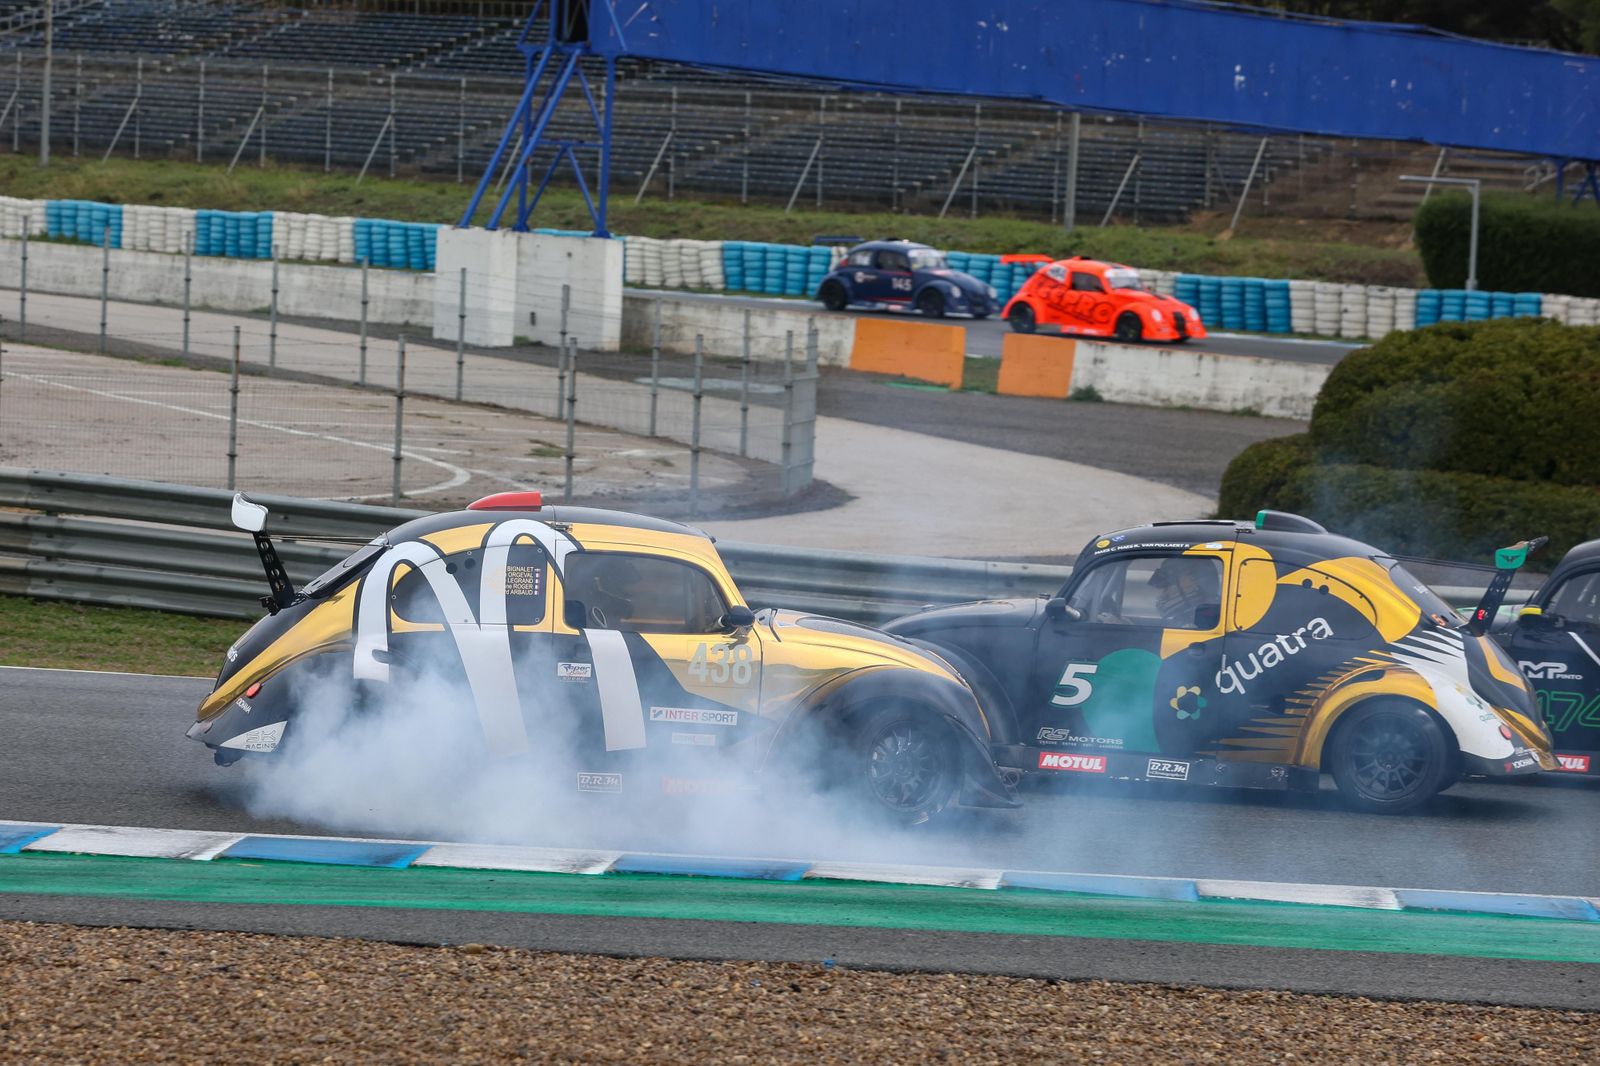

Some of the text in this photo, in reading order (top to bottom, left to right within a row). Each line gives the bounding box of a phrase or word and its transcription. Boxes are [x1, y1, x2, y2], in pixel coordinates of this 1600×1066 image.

[687, 643, 753, 684] 438
[1215, 617, 1334, 695] quatra
[1051, 664, 1098, 706] 5
[245, 742, 277, 750] RACING
[1068, 736, 1124, 745] MOTORS
[1041, 755, 1103, 770] MOTUL
[1557, 756, 1585, 770] TUL
